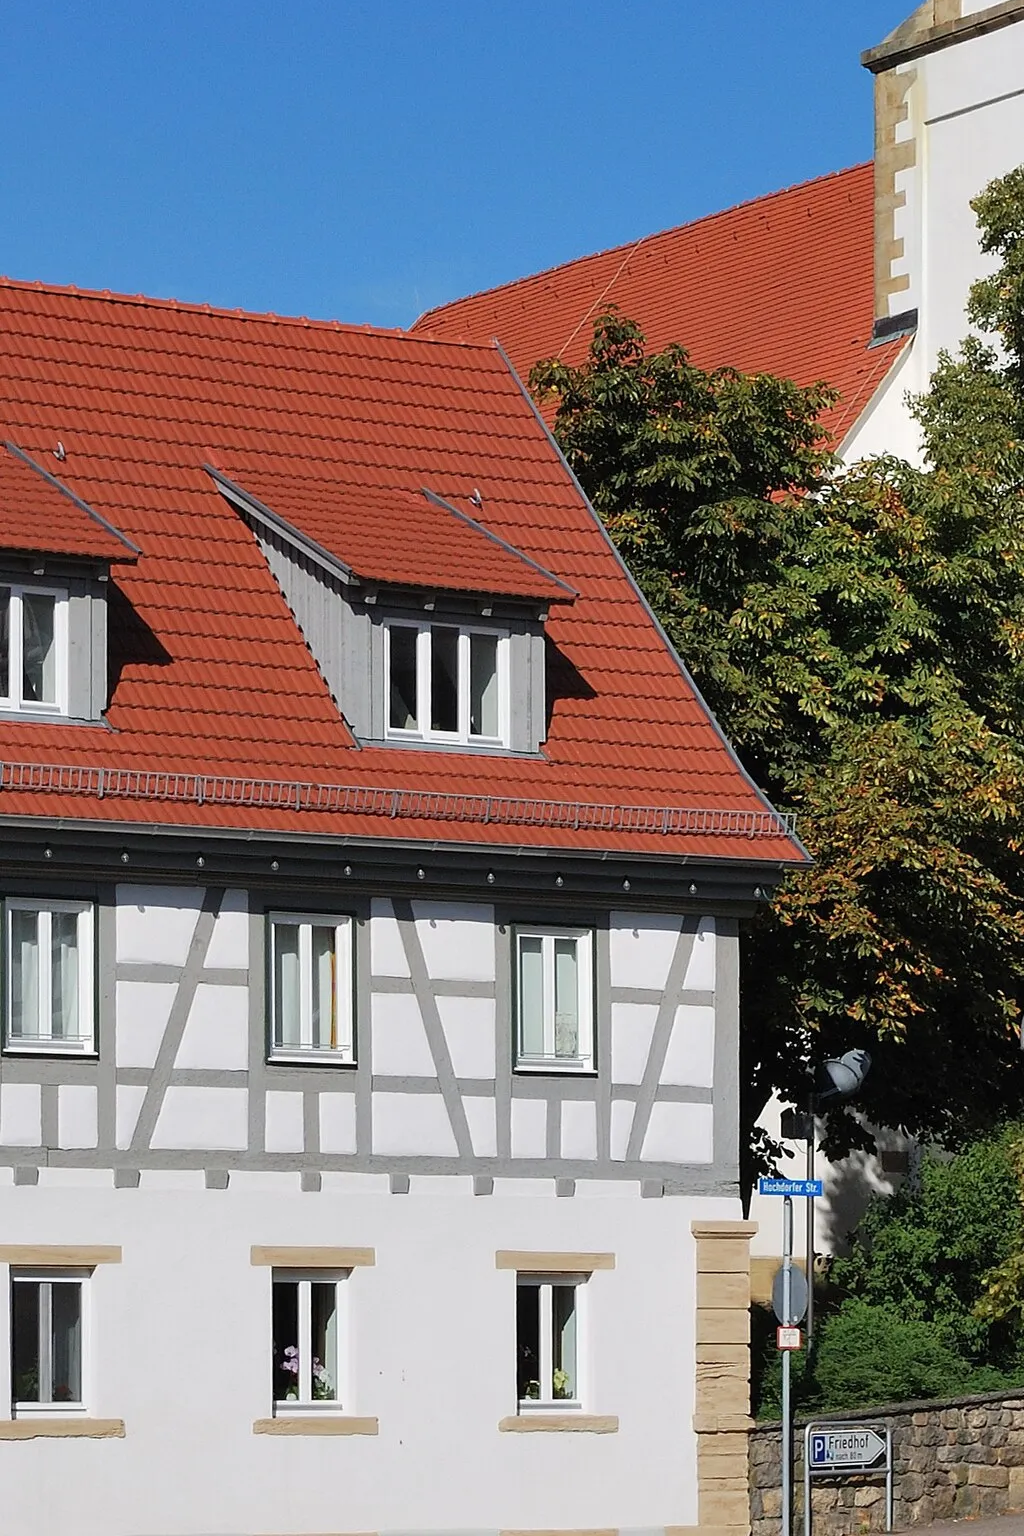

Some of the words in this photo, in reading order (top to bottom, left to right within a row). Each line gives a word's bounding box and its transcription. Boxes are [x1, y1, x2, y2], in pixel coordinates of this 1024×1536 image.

[763, 1182, 803, 1192] Hochdorfer
[805, 1182, 819, 1193] Str.
[815, 1439, 824, 1459] P
[828, 1434, 869, 1450] Friedhof
